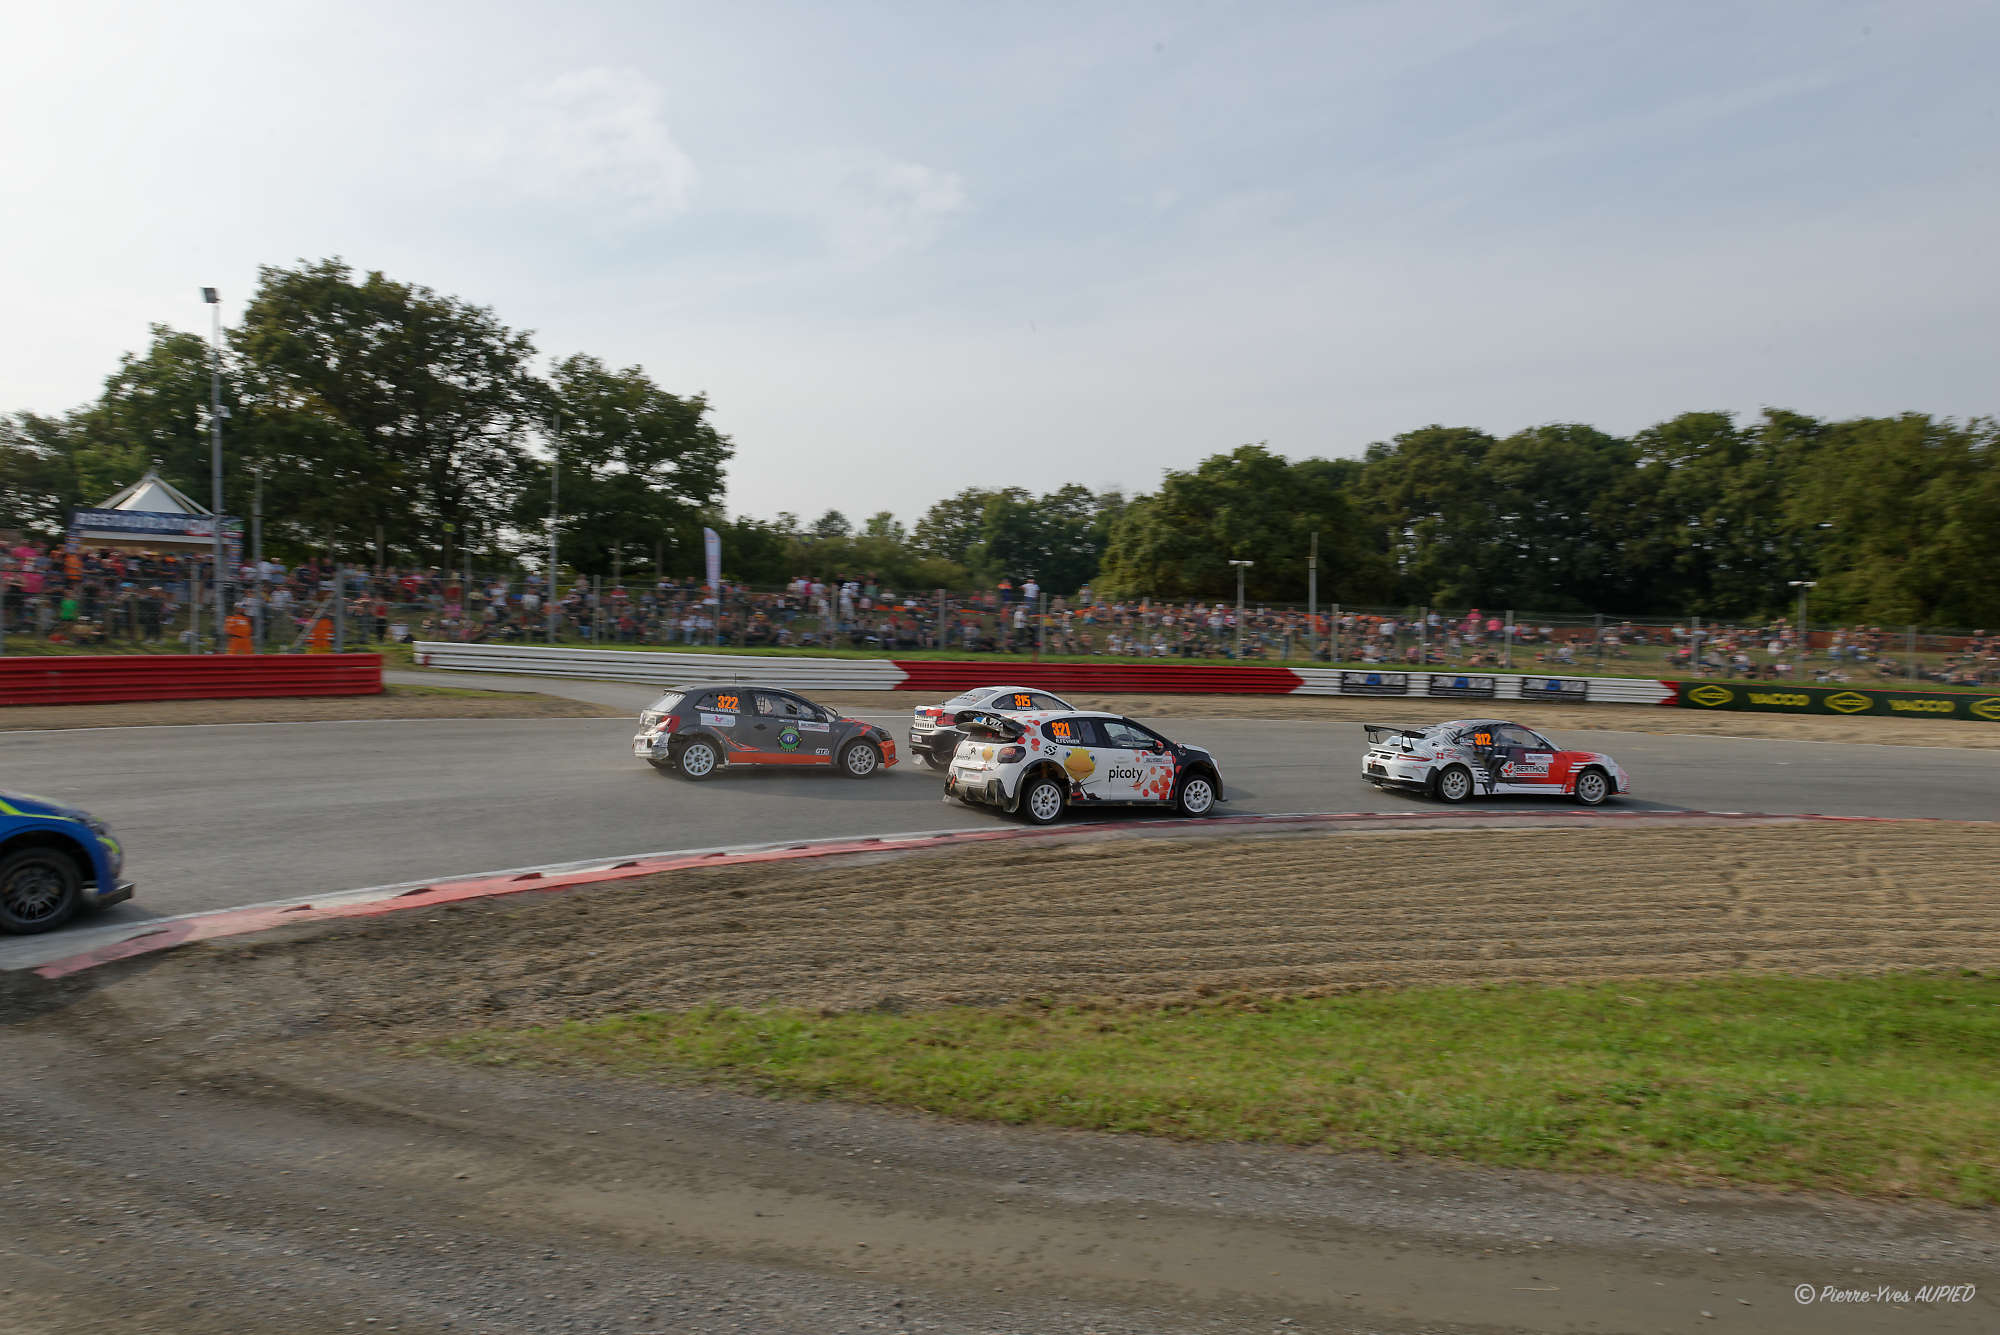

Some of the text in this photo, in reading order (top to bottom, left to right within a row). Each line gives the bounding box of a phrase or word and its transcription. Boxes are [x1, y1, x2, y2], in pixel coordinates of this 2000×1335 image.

[717, 695, 739, 709] 322
[1014, 694, 1031, 707] 315
[1051, 721, 1071, 736] 321
[1474, 733, 1493, 746] 312
[1108, 765, 1144, 783] picoty
